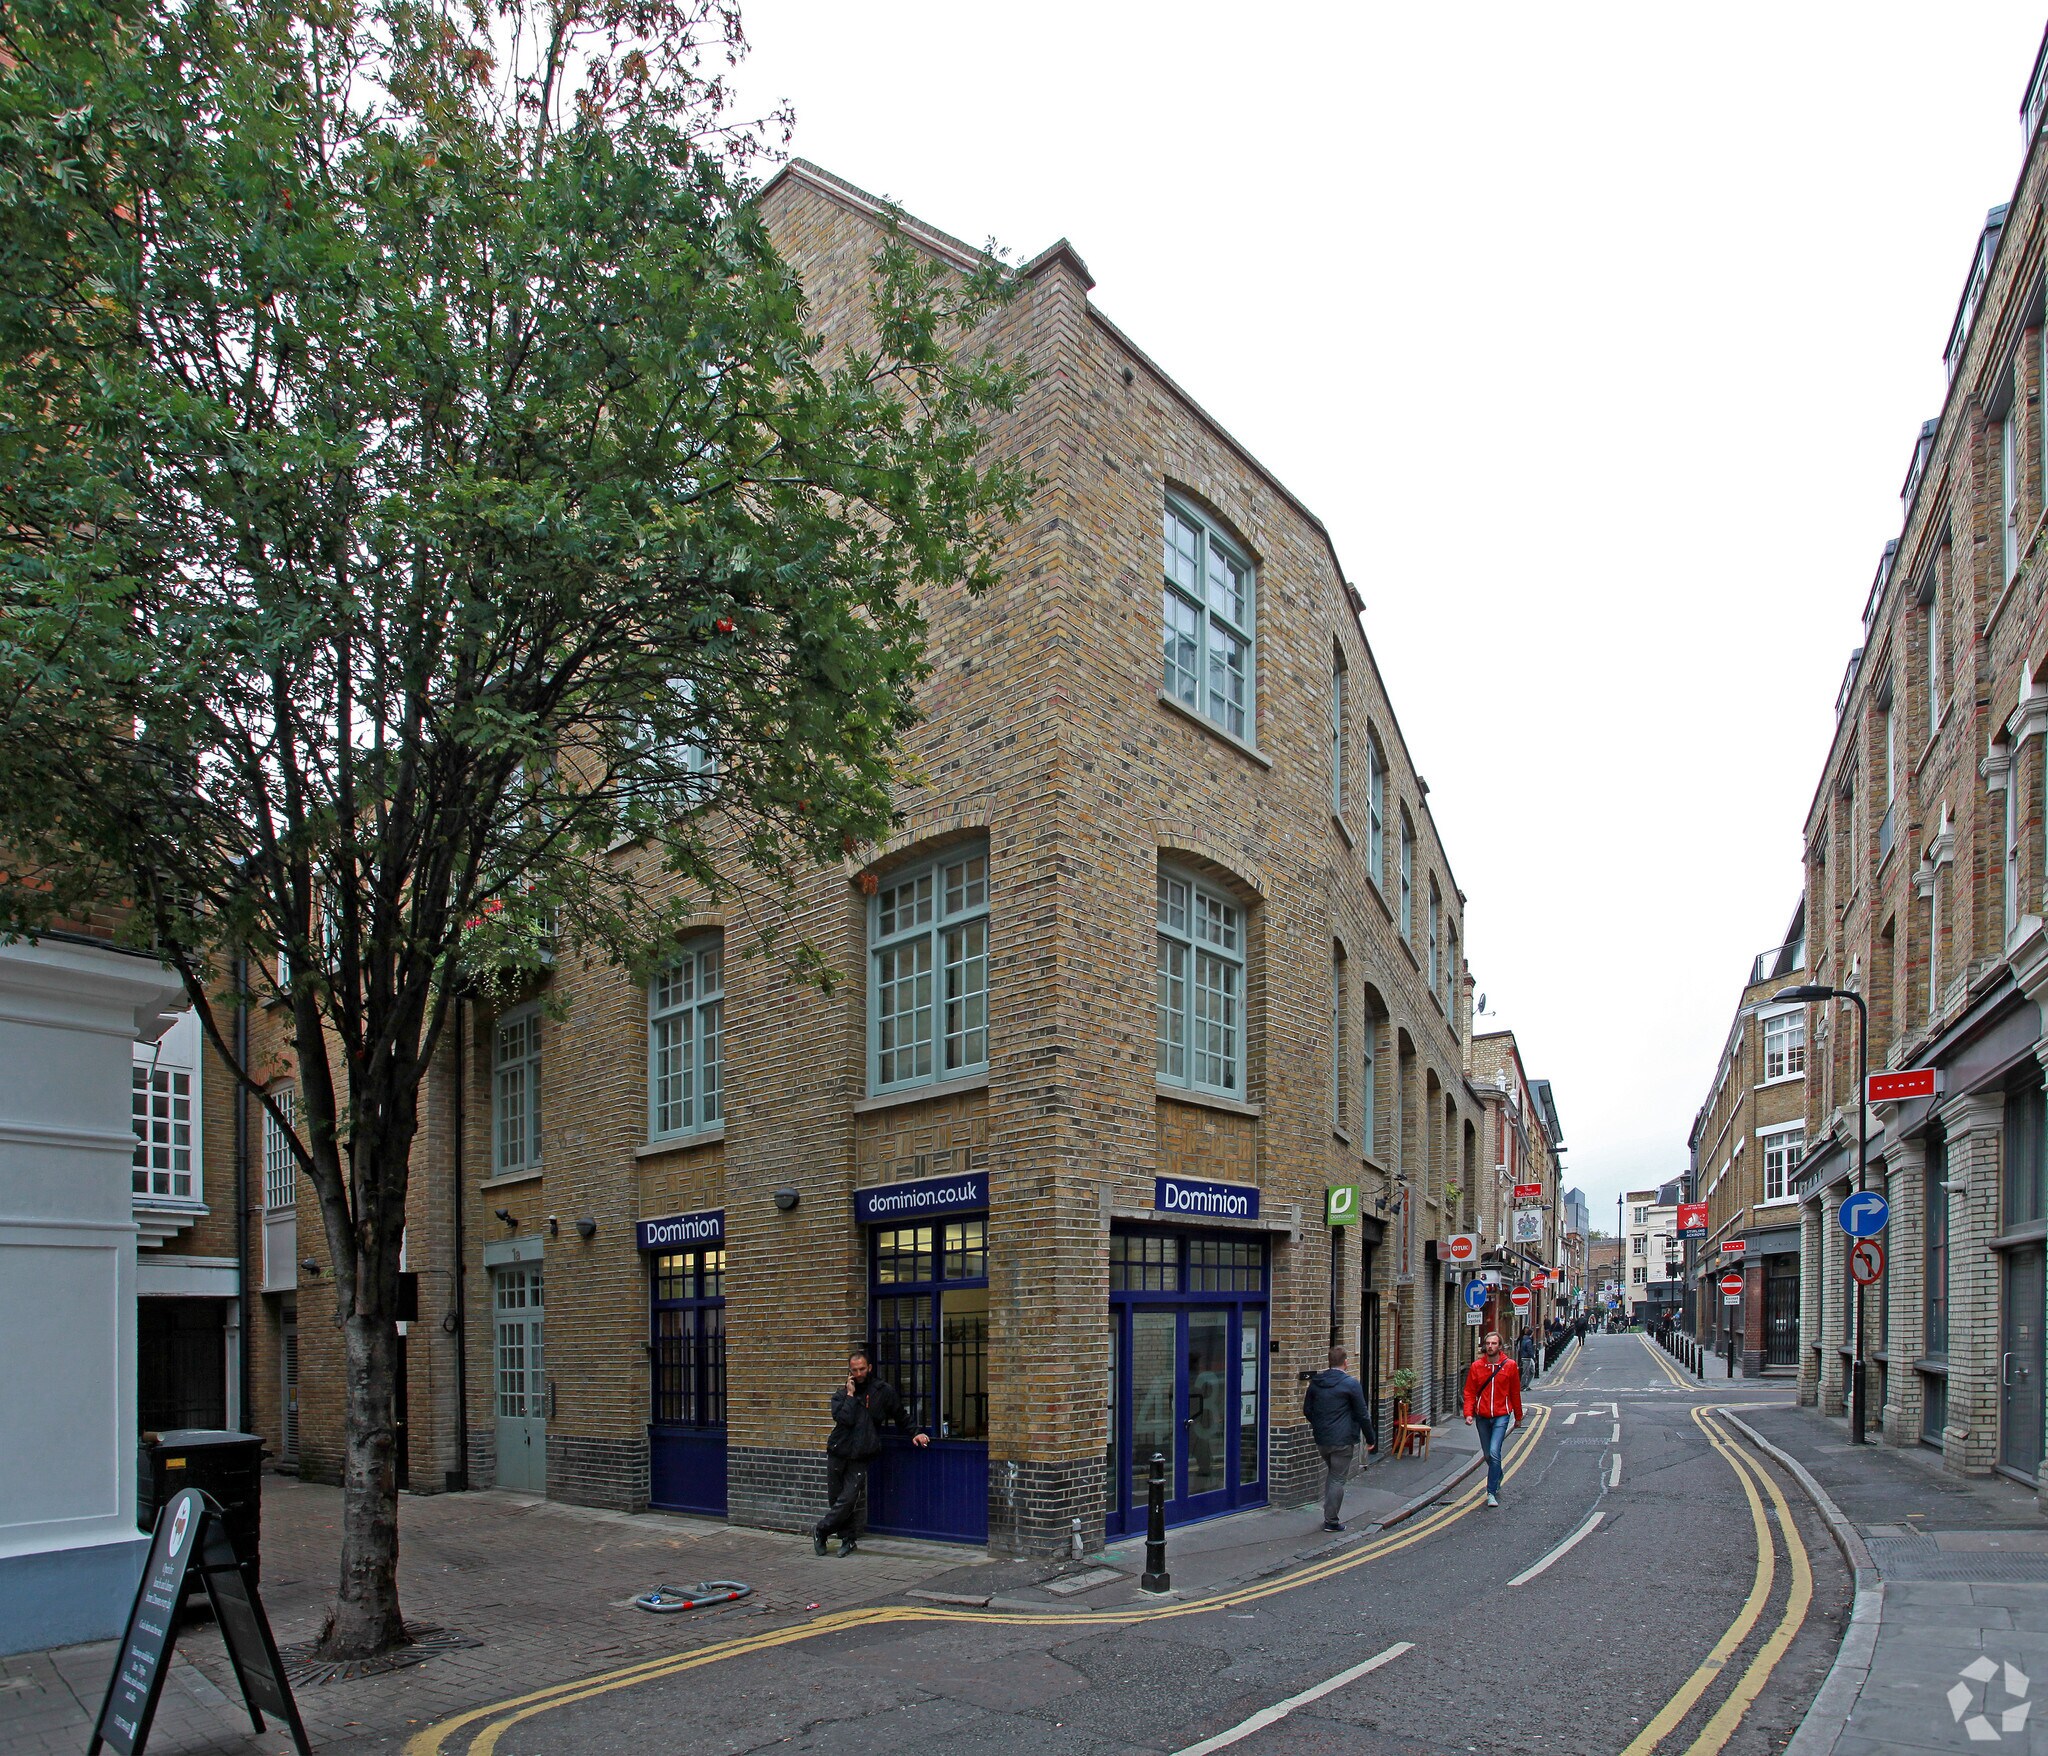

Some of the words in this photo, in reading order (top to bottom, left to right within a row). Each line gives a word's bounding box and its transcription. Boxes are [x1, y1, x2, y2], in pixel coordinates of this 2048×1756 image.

[868, 1181, 977, 1212] dominion.co.uk
[1165, 1183, 1248, 1215] Dominion
[647, 1216, 720, 1244] Dominion
[511, 1247, 521, 1261] 1a
